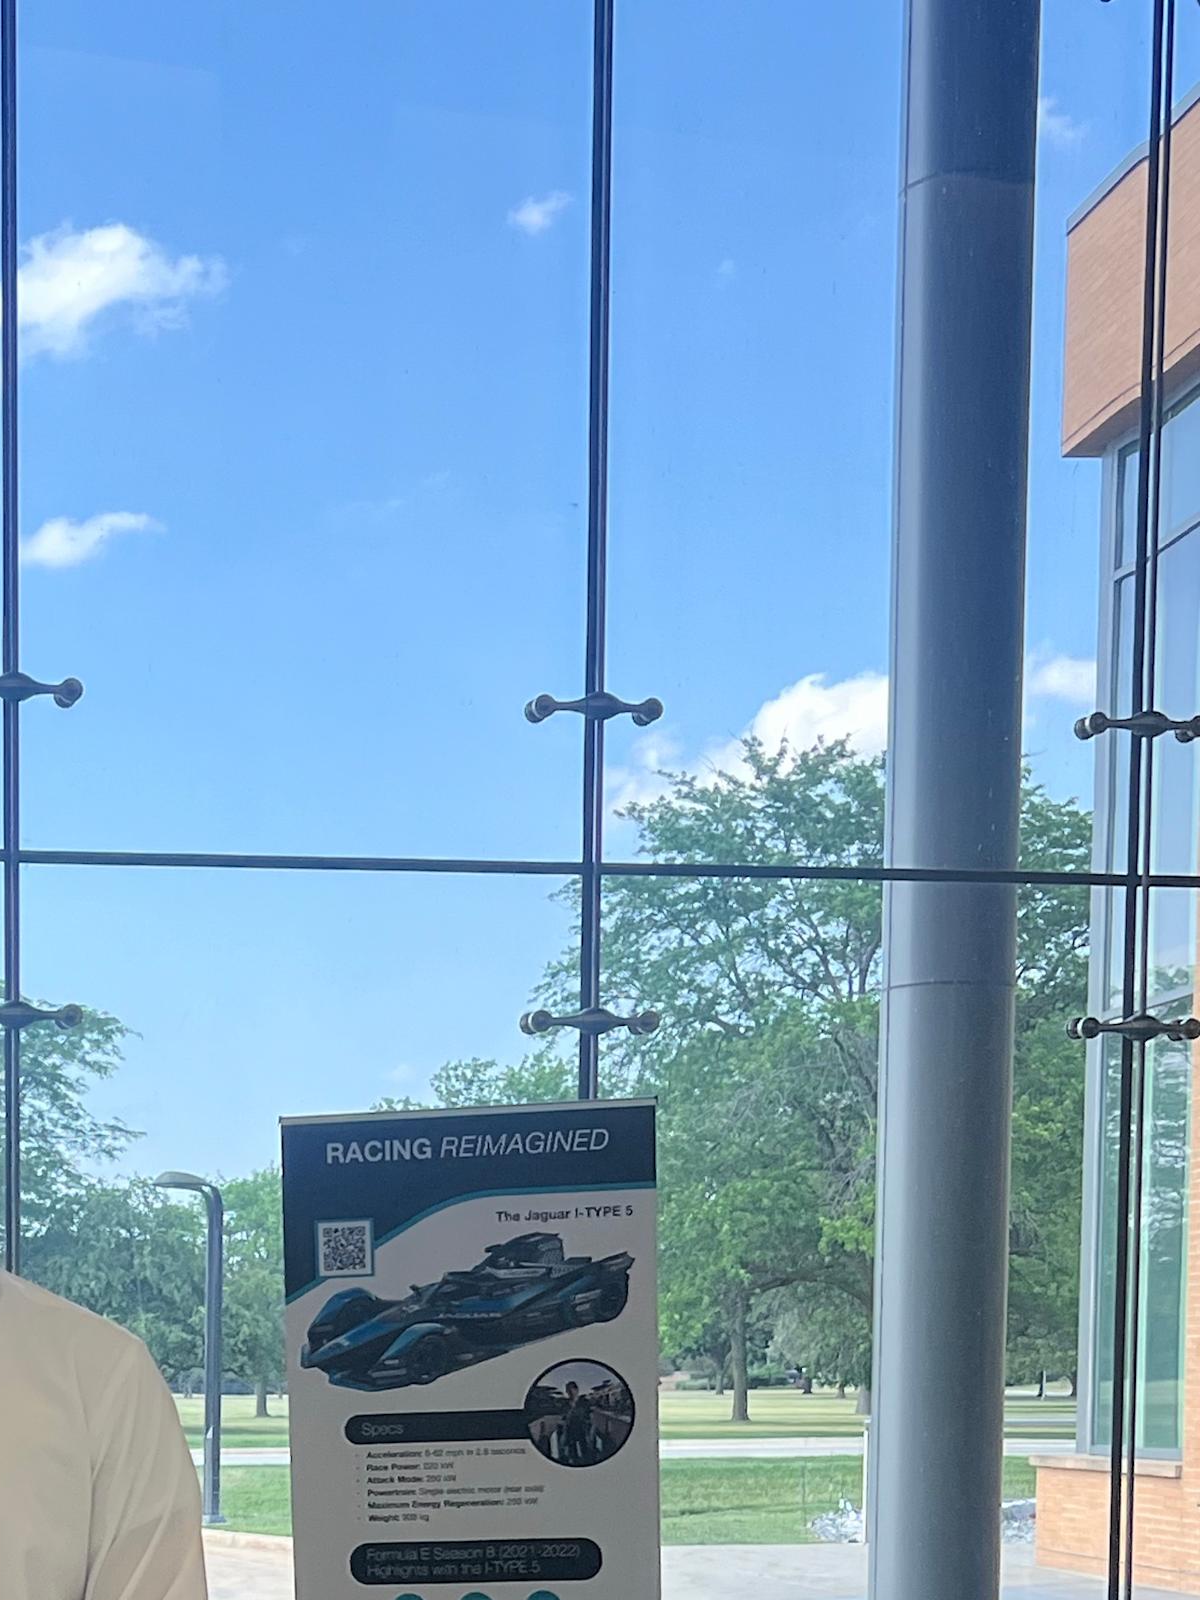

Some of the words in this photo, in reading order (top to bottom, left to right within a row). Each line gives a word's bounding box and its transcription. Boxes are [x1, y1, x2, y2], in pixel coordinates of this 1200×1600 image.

[326, 1138, 432, 1164] RACING
[440, 1128, 610, 1158] REIMAGINED
[496, 1210, 520, 1223] The
[524, 1208, 571, 1224] Jaguar
[575, 1206, 622, 1220] I-TYPE
[625, 1205, 634, 1216] 5
[361, 1422, 405, 1437] Specs
[367, 1476, 394, 1484] Attack
[366, 1548, 418, 1561] Formula
[420, 1548, 430, 1560] E
[434, 1546, 484, 1560] Season
[486, 1546, 494, 1558] 8
[498, 1544, 581, 1559] (2021-2022)
[367, 1564, 429, 1580] Highlights
[432, 1563, 458, 1576] with
[460, 1562, 482, 1576] the
[485, 1560, 528, 1574] I-TYPE
[532, 1560, 541, 1574] 5
